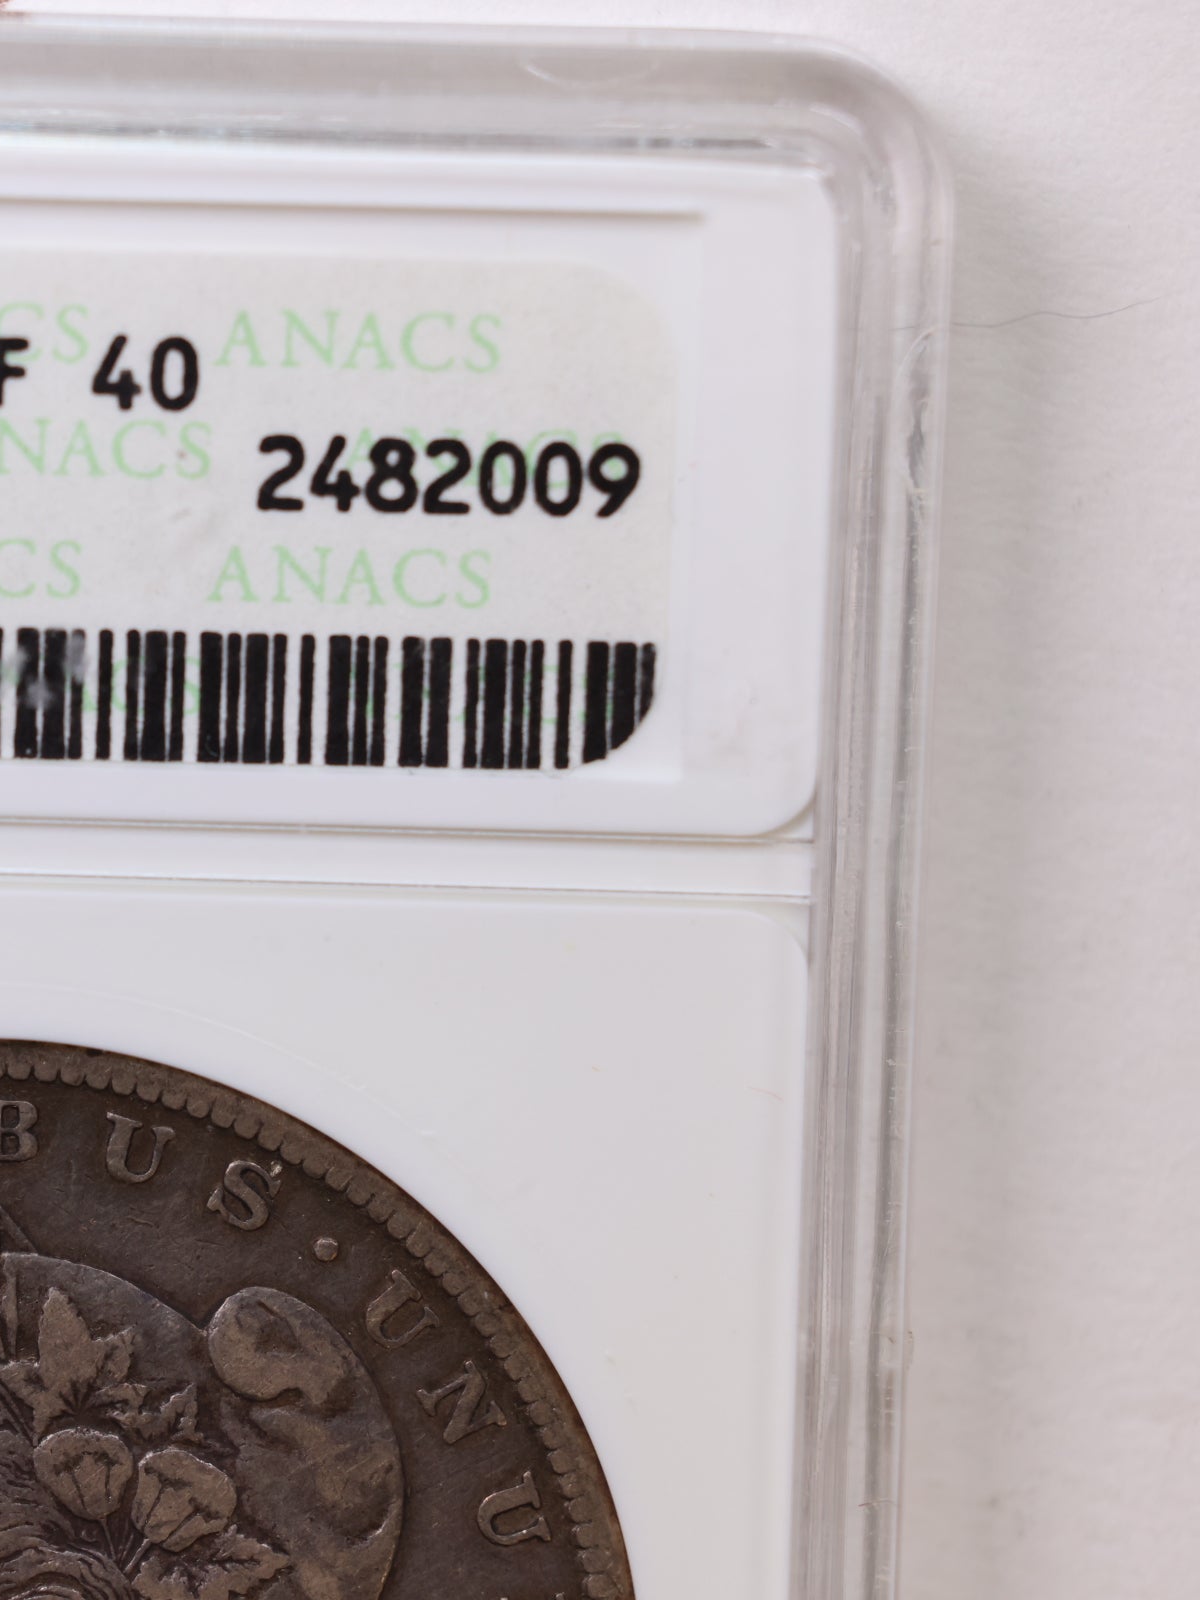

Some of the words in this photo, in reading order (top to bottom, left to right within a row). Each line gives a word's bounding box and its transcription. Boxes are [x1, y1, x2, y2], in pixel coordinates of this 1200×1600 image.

[91, 335, 199, 412] 40
[214, 309, 502, 373] ANACS
[256, 434, 641, 518] 2482009
[207, 545, 492, 609] ANACS
[365, 1269, 566, 1600] UNU
